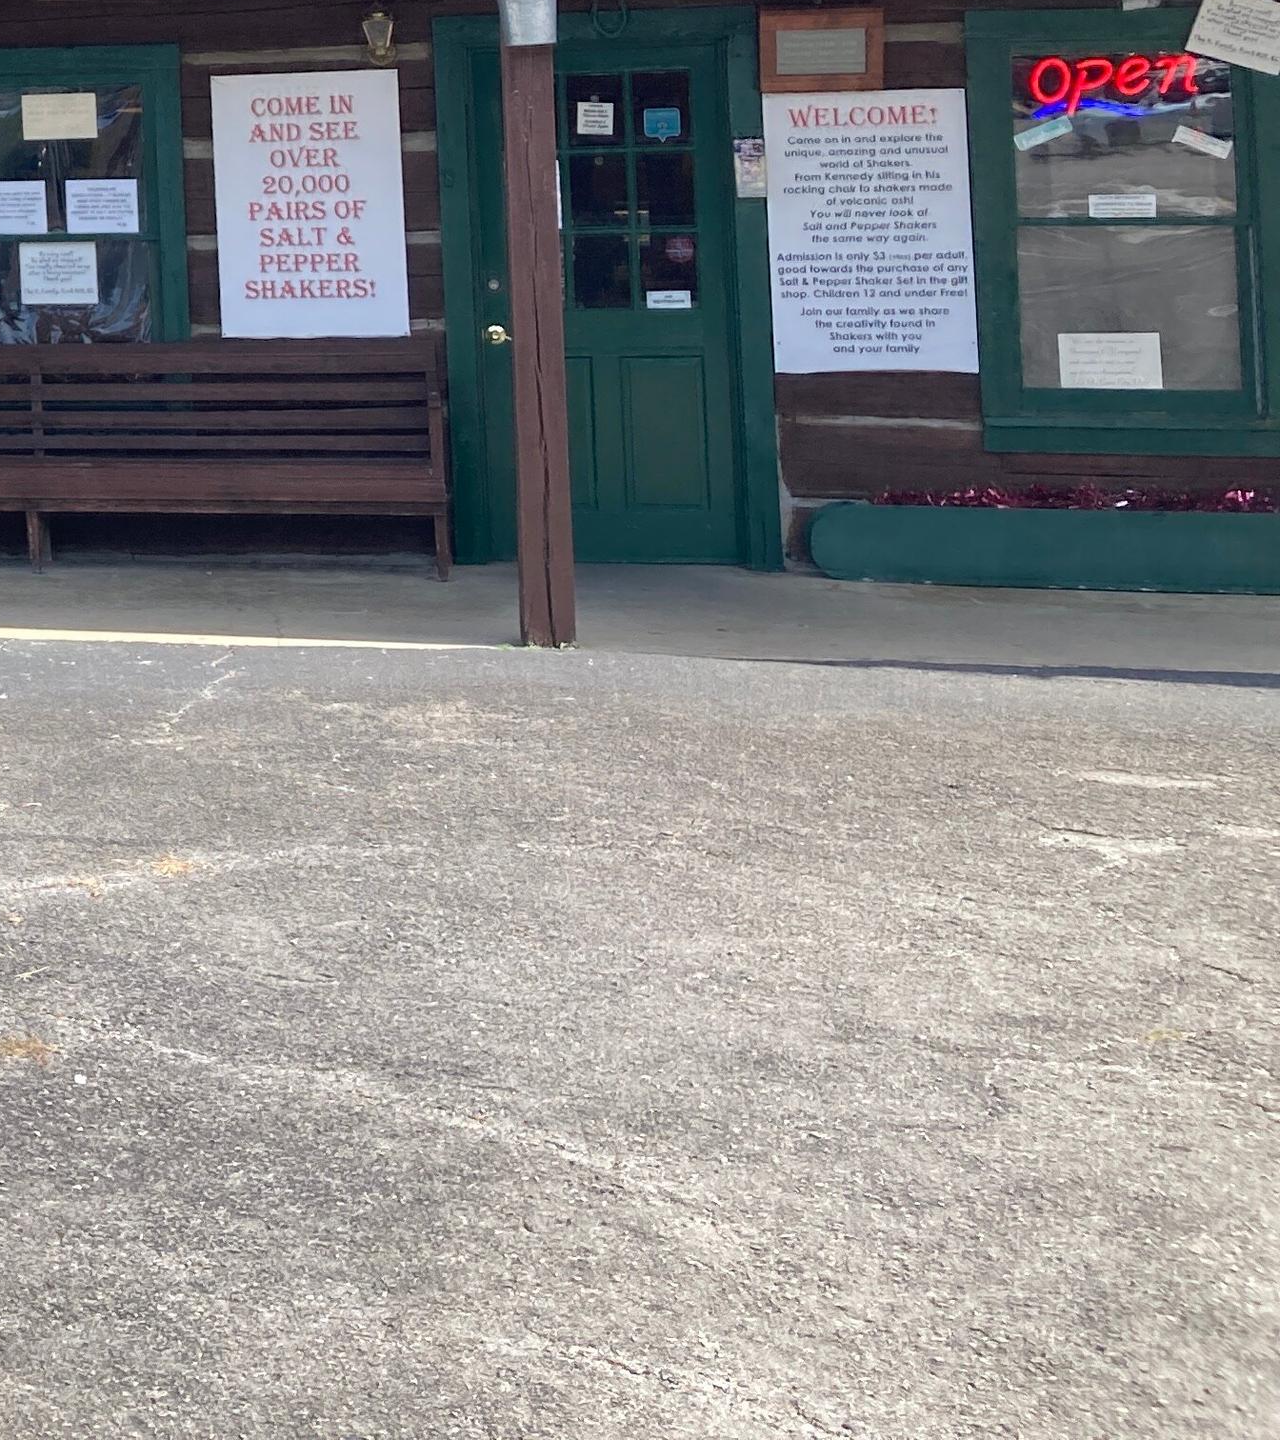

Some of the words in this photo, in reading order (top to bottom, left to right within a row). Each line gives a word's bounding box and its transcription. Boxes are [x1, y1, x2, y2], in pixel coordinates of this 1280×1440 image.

[250, 96, 322, 117] COME
[329, 95, 354, 115] IN
[787, 104, 939, 128] WELCOME!
[249, 123, 301, 143] AND
[308, 121, 360, 141] SEE
[787, 136, 821, 145] Come
[824, 136, 839, 144] on
[841, 135, 851, 143] in
[854, 135, 876, 143] and
[879, 135, 922, 144] explore
[925, 133, 943, 141] the
[270, 145, 340, 168] OVER
[828, 148, 876, 157] amazing
[880, 146, 902, 154] and
[905, 145, 948, 154] unusual
[819, 160, 850, 168] world
[853, 160, 864, 168] of
[794, 173, 822, 181] From
[824, 172, 874, 181] Kennedy
[877, 171, 909, 181] sitting
[912, 171, 923, 179] in
[262, 174, 350, 197] 20,000
[783, 184, 825, 195] rocking
[828, 185, 856, 193] chair
[873, 184, 916, 192] shakers
[919, 183, 953, 191] made
[826, 197, 836, 205] of
[840, 197, 887, 205] volcanic
[248, 201, 326, 221] PAIRS
[334, 200, 367, 220] OF
[810, 209, 832, 218] You
[834, 209, 852, 217] will
[855, 209, 886, 217] never
[889, 208, 914, 217] look
[917, 208, 929, 216] at
[803, 222, 823, 231] Salt
[826, 222, 847, 230] and
[850, 222, 890, 231] Pepper
[894, 220, 937, 229] Shakers
[259, 227, 327, 247] SALT
[337, 227, 355, 245] &
[812, 234, 829, 243] the
[832, 234, 863, 243] same
[866, 235, 889, 244] way
[777, 252, 832, 261] Admission
[835, 252, 843, 261] is
[846, 252, 869, 261] only
[873, 252, 886, 261] $3
[914, 252, 932, 261] per
[259, 253, 361, 273] PEPPER
[778, 265, 806, 275] good
[810, 265, 853, 273] towards
[856, 264, 873, 272] the
[877, 265, 929, 273] purchase
[779, 277, 799, 286] Salt
[813, 277, 851, 286] Pepper
[855, 276, 893, 285] Shaker
[896, 276, 913, 285] Set
[916, 276, 926, 284] in
[930, 276, 947, 284] the
[951, 276, 968, 286] gift
[244, 279, 376, 299] SHAKERS!
[813, 289, 859, 298] Children
[864, 289, 876, 297] 12
[879, 288, 901, 297] and
[905, 288, 937, 297] under
[941, 288, 968, 297] Free!
[801, 307, 822, 316] Join
[846, 307, 879, 316] family
[919, 307, 949, 315] share
[815, 320, 832, 328] the
[836, 320, 887, 329] creativity
[890, 319, 922, 328] found
[925, 319, 935, 327] in
[830, 332, 872, 340] Shakers
[876, 332, 898, 340] with
[901, 333, 922, 341] you
[833, 345, 855, 353] and
[859, 345, 882, 353] your
